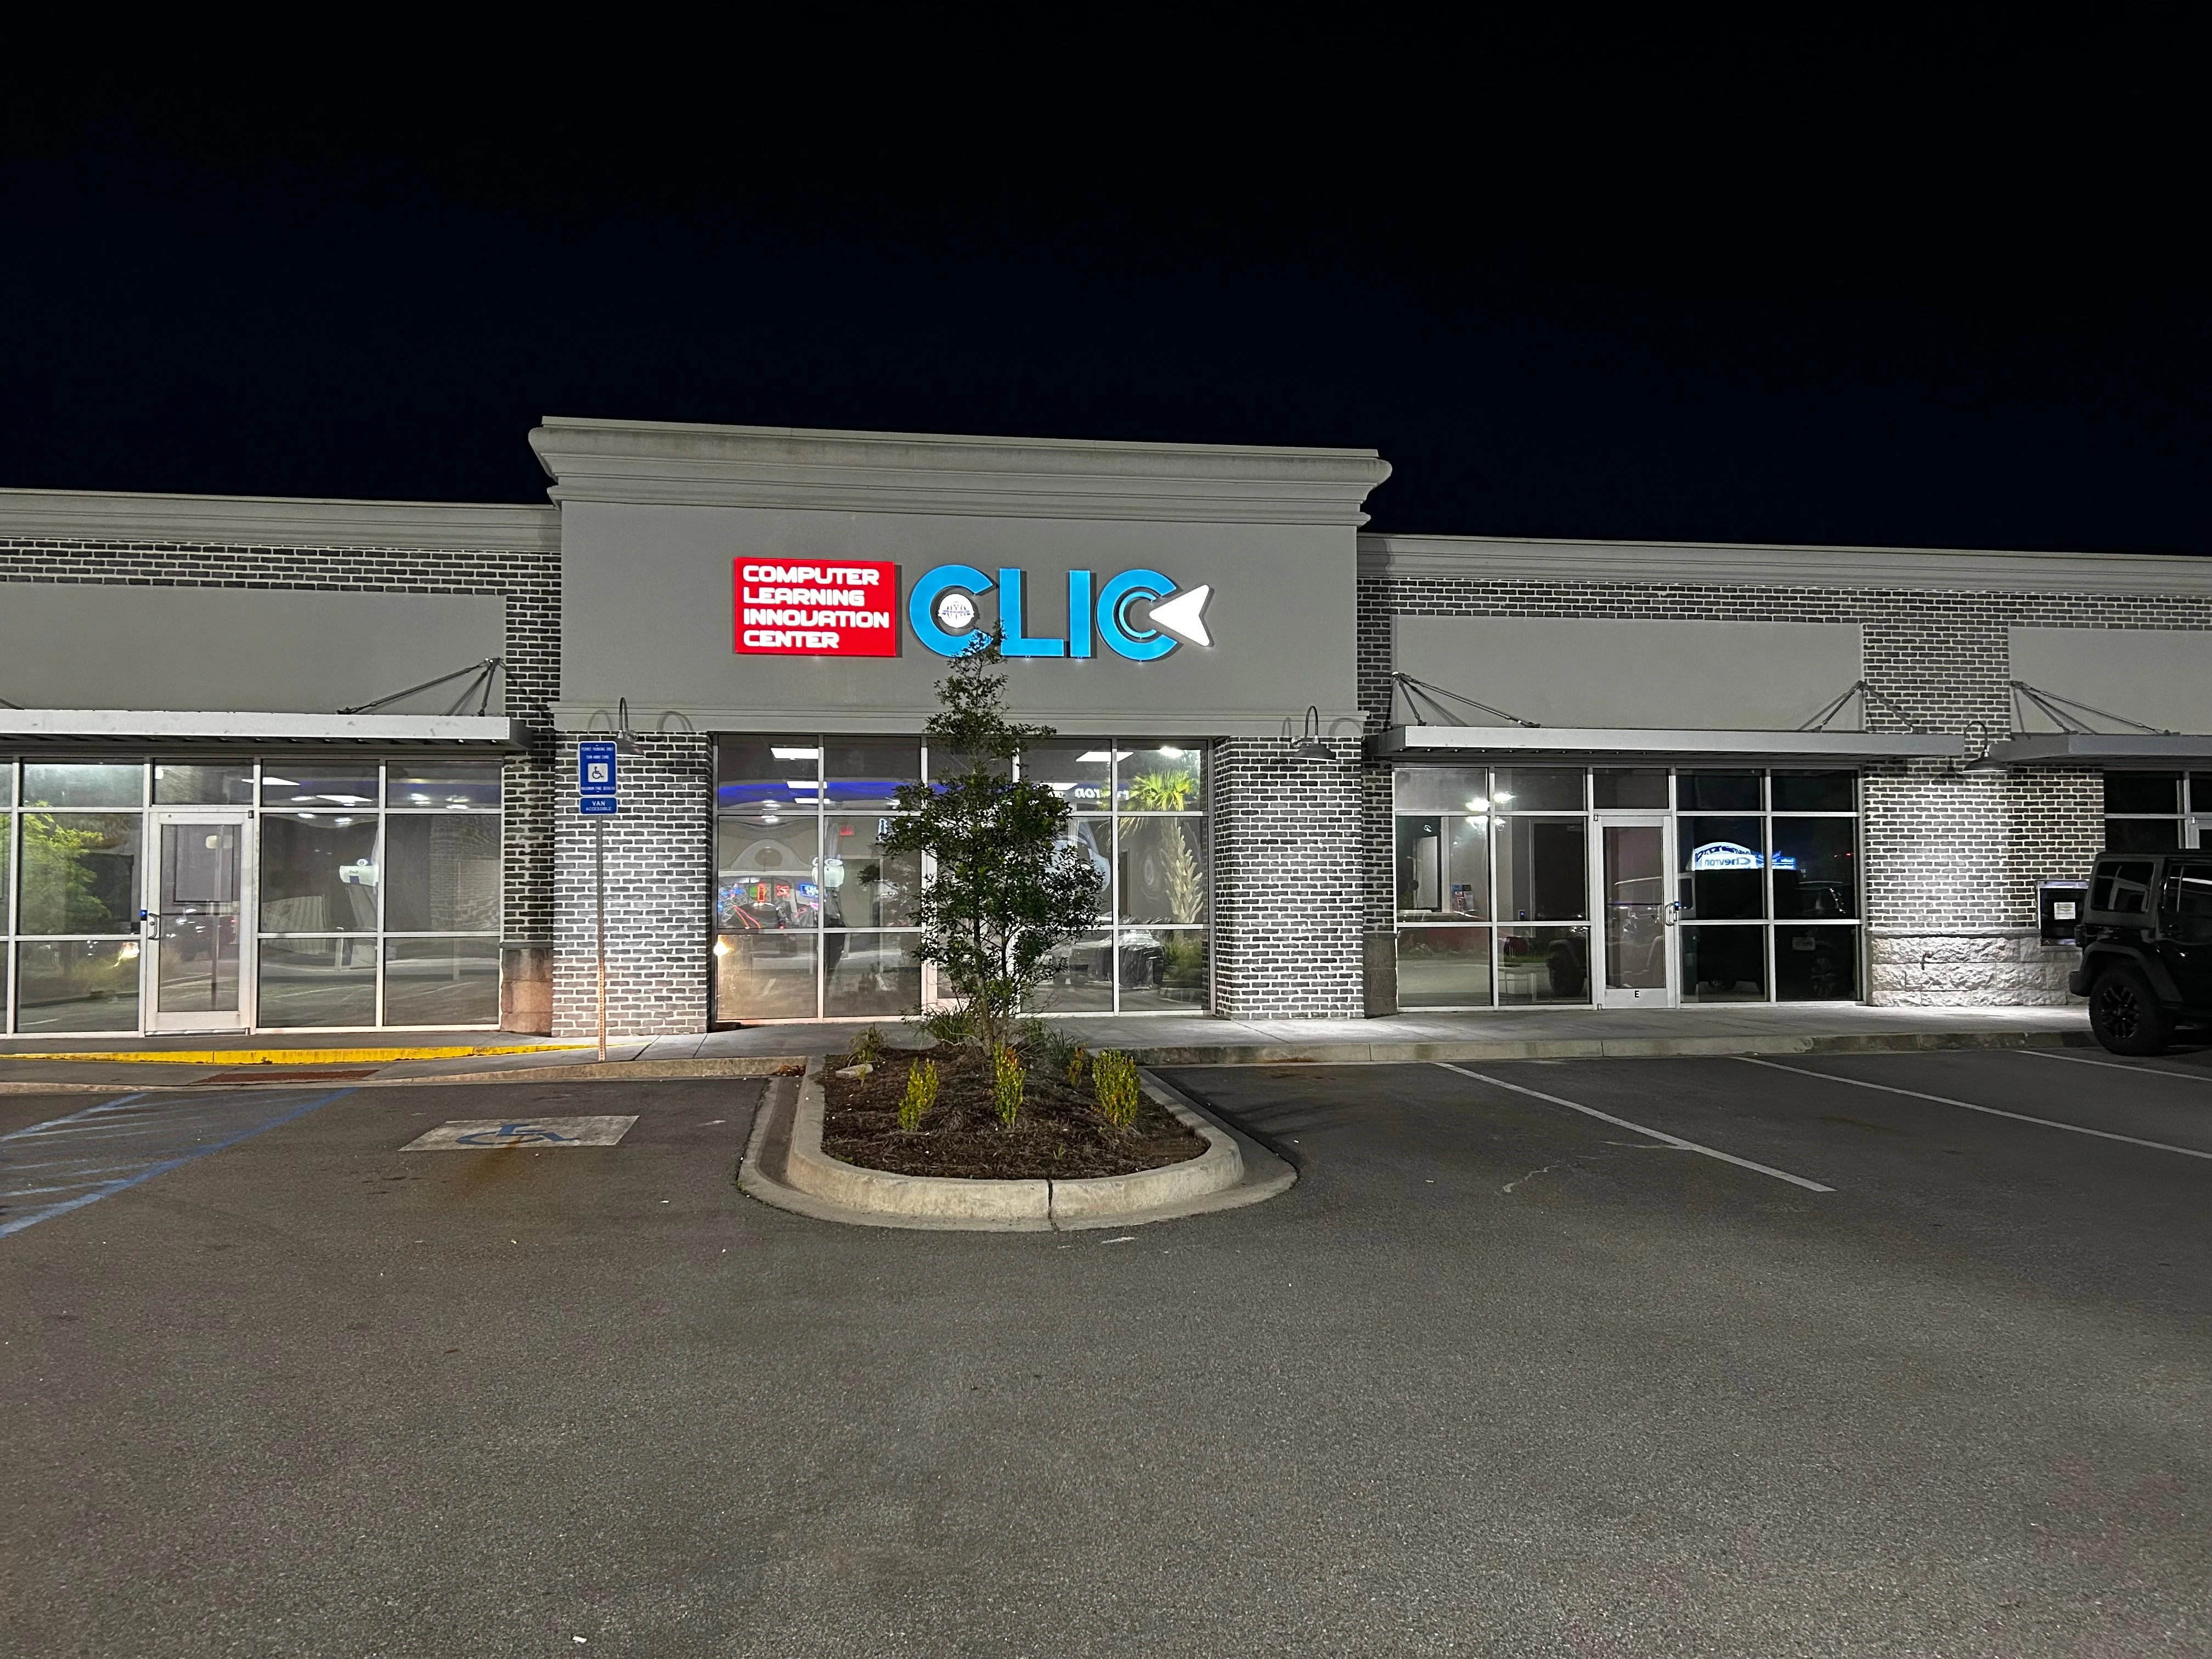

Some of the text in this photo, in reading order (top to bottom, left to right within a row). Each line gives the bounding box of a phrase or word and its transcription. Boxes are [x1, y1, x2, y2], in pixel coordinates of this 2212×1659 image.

[743, 565, 879, 585] COMPUTER
[743, 587, 865, 606] LEARNING
[743, 608, 889, 628] INNOVATION
[909, 564, 1178, 661] CLIC
[743, 630, 839, 648] CENTER
